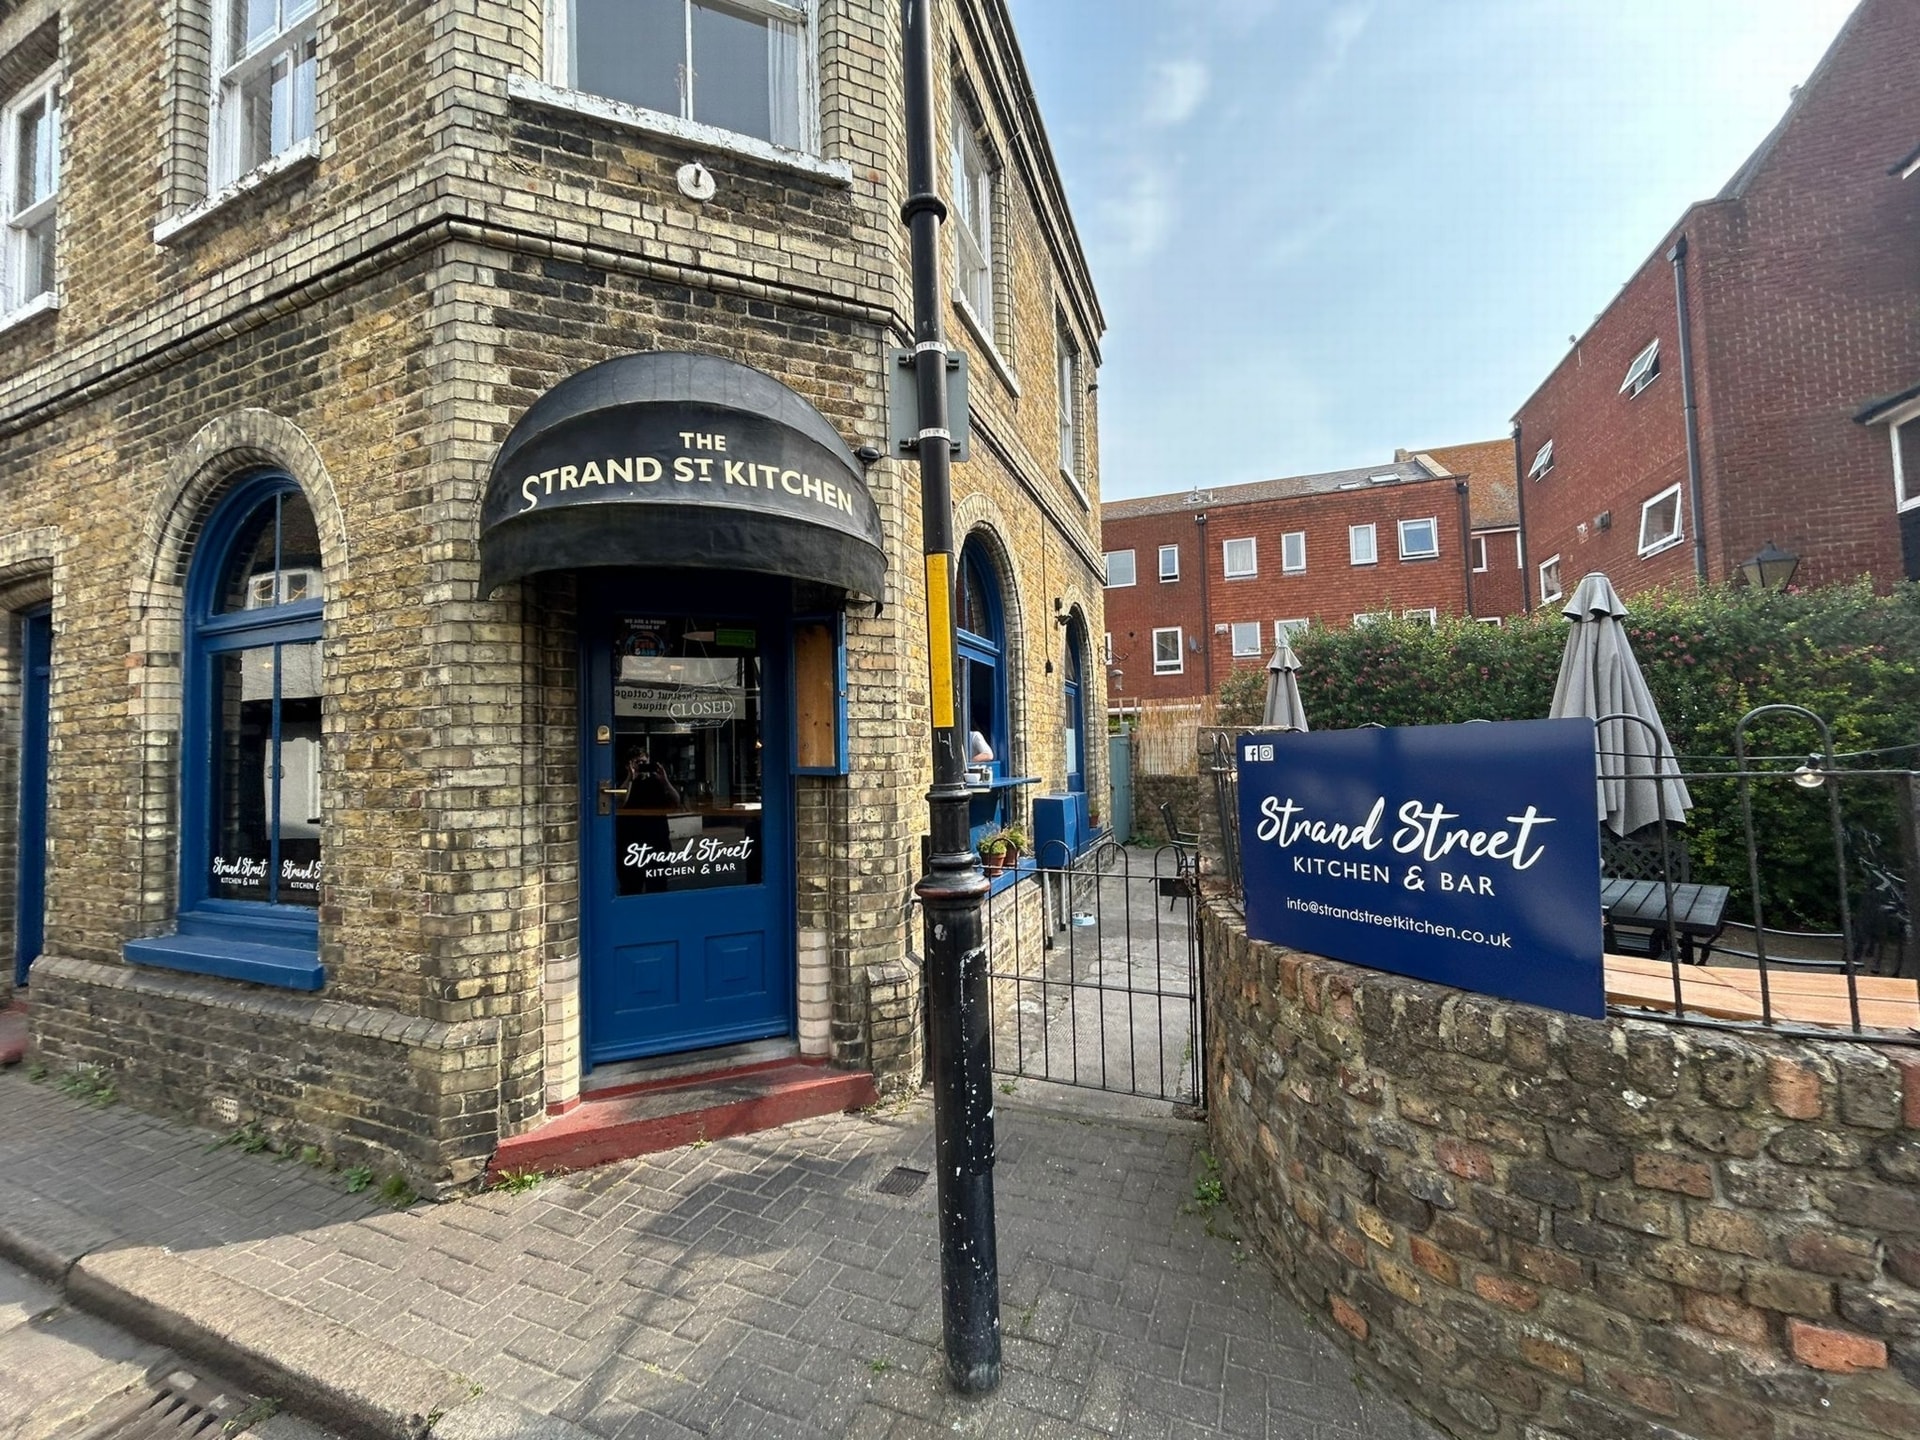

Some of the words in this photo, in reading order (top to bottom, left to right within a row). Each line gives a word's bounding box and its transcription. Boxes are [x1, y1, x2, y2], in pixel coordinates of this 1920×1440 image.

[679, 432, 726, 452] THE
[519, 457, 662, 513] STRAND
[674, 457, 714, 483] ST
[725, 460, 853, 516] KITCHEN
[670, 700, 733, 718] CLOSED
[1257, 796, 1385, 850] Strand
[1392, 800, 1557, 870] Street
[623, 838, 694, 868] Strand
[696, 836, 754, 864] Street
[212, 856, 242, 876] Strand
[241, 857, 269, 877] Street
[281, 859, 314, 880] Strand
[645, 865, 696, 878] KITCHEN
[700, 863, 711, 875] &
[715, 863, 736, 872] BAR
[1293, 856, 1390, 884] KITCHEN
[1403, 865, 1425, 892] &
[1440, 872, 1495, 897] BAR
[220, 877, 242, 885] KITCHEN
[242, 877, 248, 886] &
[249, 878, 259, 886] BAR
[290, 881, 314, 890] KITCHEN
[1286, 896, 1512, 949] info@strandstreetkitchen.co.uk
